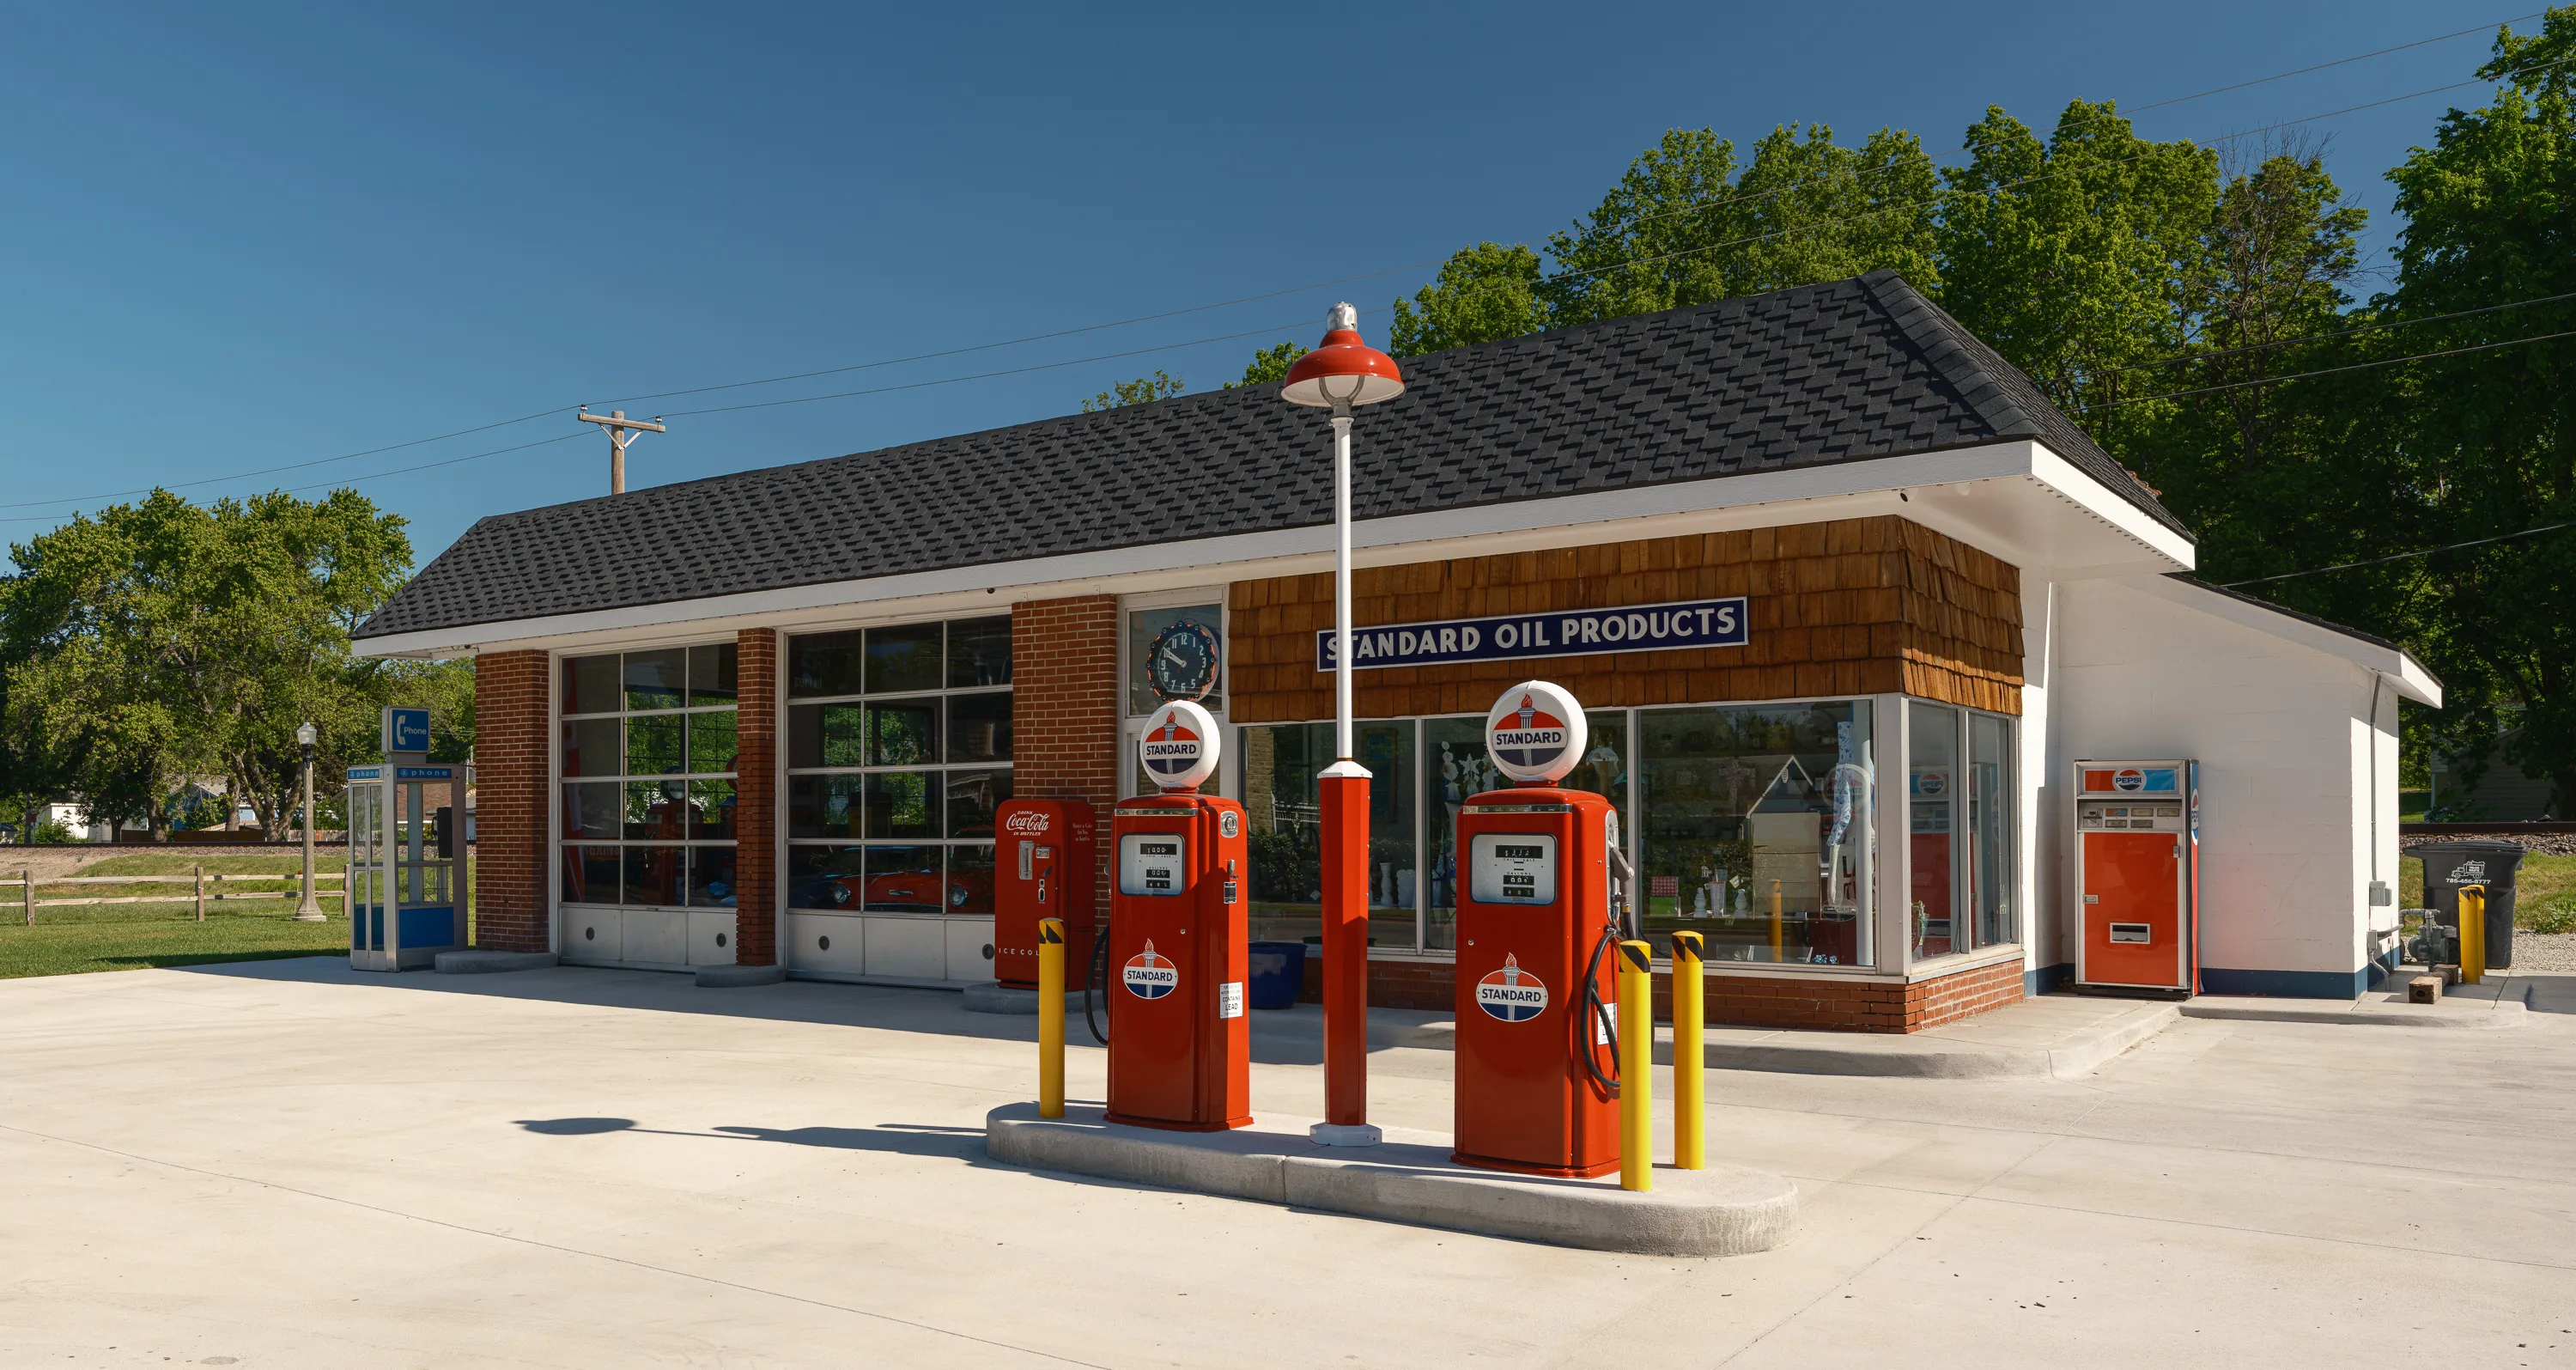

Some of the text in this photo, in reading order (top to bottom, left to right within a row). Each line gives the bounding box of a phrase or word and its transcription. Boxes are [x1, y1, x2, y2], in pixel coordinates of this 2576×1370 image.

[1495, 621, 1550, 648] OIL
[1562, 606, 1735, 644] PRODUCTS
[1171, 638, 1177, 648] 11
[1181, 634, 1188, 645] 12
[1199, 645, 1204, 656] 2
[1161, 660, 1166, 670] 9
[1201, 657, 1206, 668] 3
[1163, 672, 1169, 682] 8
[1198, 669, 1204, 678] 4
[1171, 679, 1176, 690] 7
[1181, 683, 1186, 693] 6
[1191, 679, 1196, 689] 5
[1496, 732, 1562, 746] STANDARD
[1146, 744, 1197, 756] STANDARD
[356, 769, 379, 777] phone
[1005, 813, 1049, 831] Coca-Cola
[1127, 970, 1173, 982] STANDARD
[1481, 988, 1541, 1002] STANDARD
[1225, 1002, 1238, 1011] LEAD
